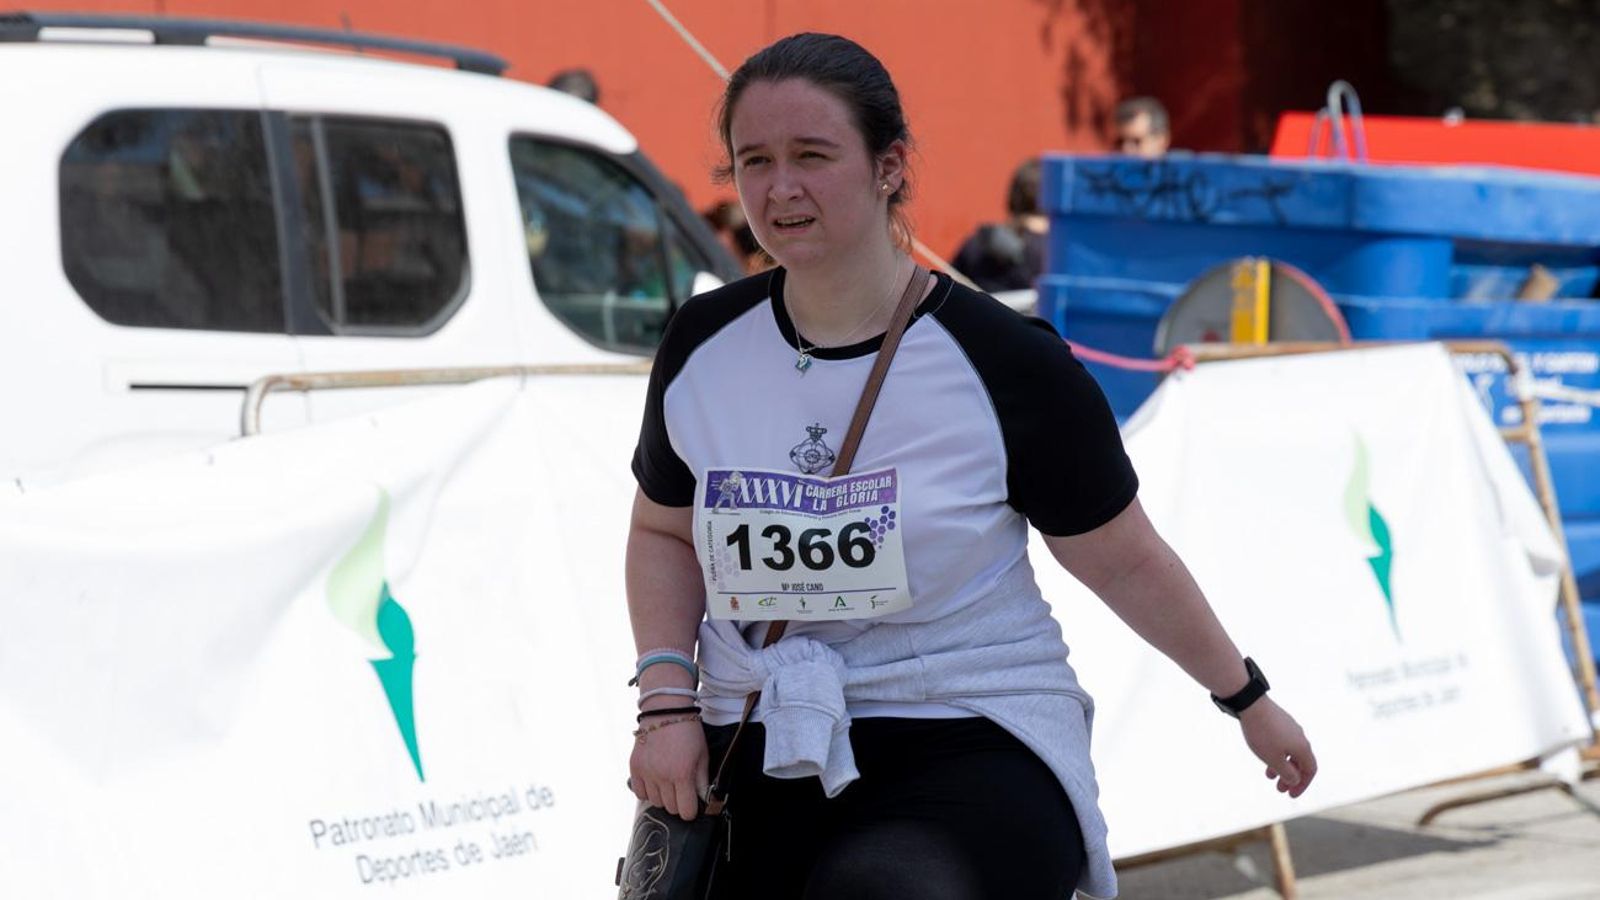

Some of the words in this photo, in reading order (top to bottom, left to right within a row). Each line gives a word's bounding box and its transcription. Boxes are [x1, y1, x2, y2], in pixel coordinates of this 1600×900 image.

[736, 477, 803, 508] XXXVI
[805, 483, 849, 499] CARRERA
[850, 475, 892, 494] ESCOLAR
[812, 498, 828, 512] LA
[836, 489, 878, 508] GLORIA
[726, 521, 876, 571] 1366
[309, 810, 416, 849] Patronato
[418, 785, 521, 829] Municipal
[525, 783, 556, 811] de
[355, 848, 451, 887] Deportes
[453, 838, 485, 867] de
